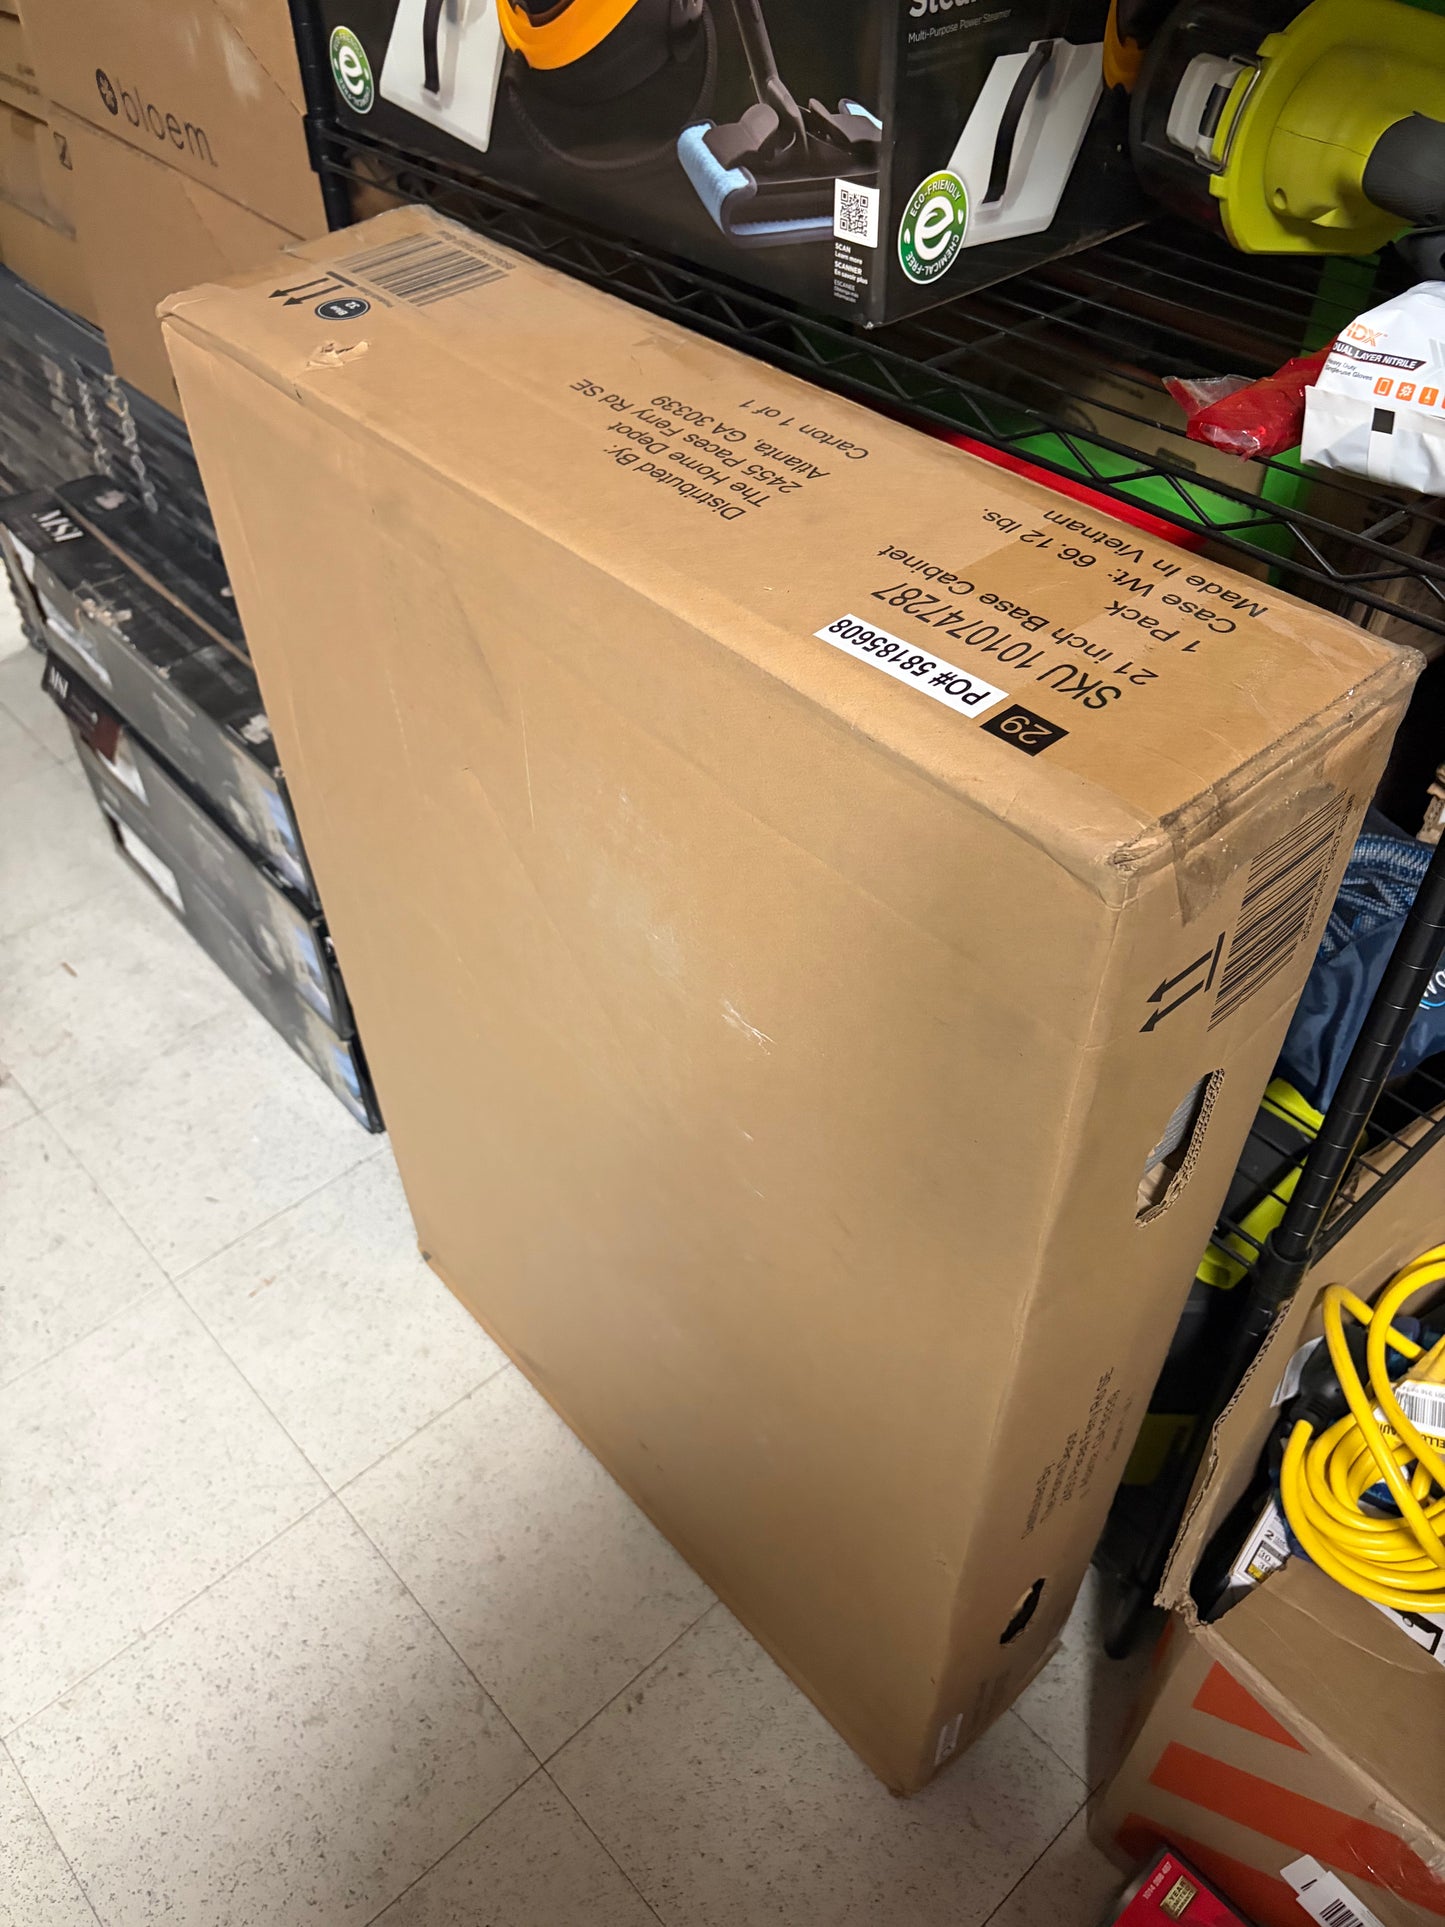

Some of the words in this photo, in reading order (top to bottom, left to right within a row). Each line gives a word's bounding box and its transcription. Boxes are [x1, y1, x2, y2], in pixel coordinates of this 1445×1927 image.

[908, 22, 958, 44] Multi-Purpose
[959, 17, 982, 30] Power
[982, 9, 1012, 23] Steamer
[116, 76, 215, 168] bloem
[910, 179, 962, 218] ECO-FRIENDLY
[835, 242, 851, 254] SCAN
[835, 250, 848, 260] Learn
[849, 257, 863, 265] more
[906, 235, 960, 276] CHEMICAL-FREE
[834, 261, 862, 275] SCANNER
[841, 272, 856, 281] savoir
[1355, 350, 1382, 364] LAYER
[1382, 354, 1418, 369] NITRILE
[568, 378, 604, 398] SE
[1352, 371, 1373, 381] Gloves
[598, 392, 634, 412] Rd
[649, 396, 714, 427] 30339
[738, 398, 755, 409] 1
[752, 406, 781, 421] of
[604, 421, 671, 454] Depot
[630, 407, 684, 438] Ferry
[708, 422, 747, 443] GA
[779, 417, 795, 428] 1
[602, 444, 637, 465] By:
[682, 433, 745, 467] Paces
[798, 424, 870, 460] Carton
[667, 450, 724, 484] Home
[754, 439, 830, 481] Atlanta,
[634, 461, 745, 521] Distributed
[740, 463, 802, 494] 2455
[729, 481, 771, 508] The
[981, 508, 1022, 534] lbs.
[1041, 509, 1145, 563] Vietnam
[1018, 529, 1097, 569] 66.12
[876, 544, 976, 598] Cabinet
[1105, 566, 1155, 597] Wt:
[1150, 558, 1181, 578] In
[1185, 574, 1268, 618] Made
[870, 581, 1045, 670] 1010747287
[977, 592, 1050, 633] Base
[1103, 600, 1180, 642] Pack
[1161, 593, 1238, 634] Case
[824, 618, 938, 677] 58185608
[1050, 626, 1114, 666] inch
[1180, 639, 1203, 653] 1
[928, 670, 991, 706] PO#
[1037, 662, 1122, 710] SKU
[1114, 660, 1159, 686] 21
[997, 714, 1053, 745] 29
